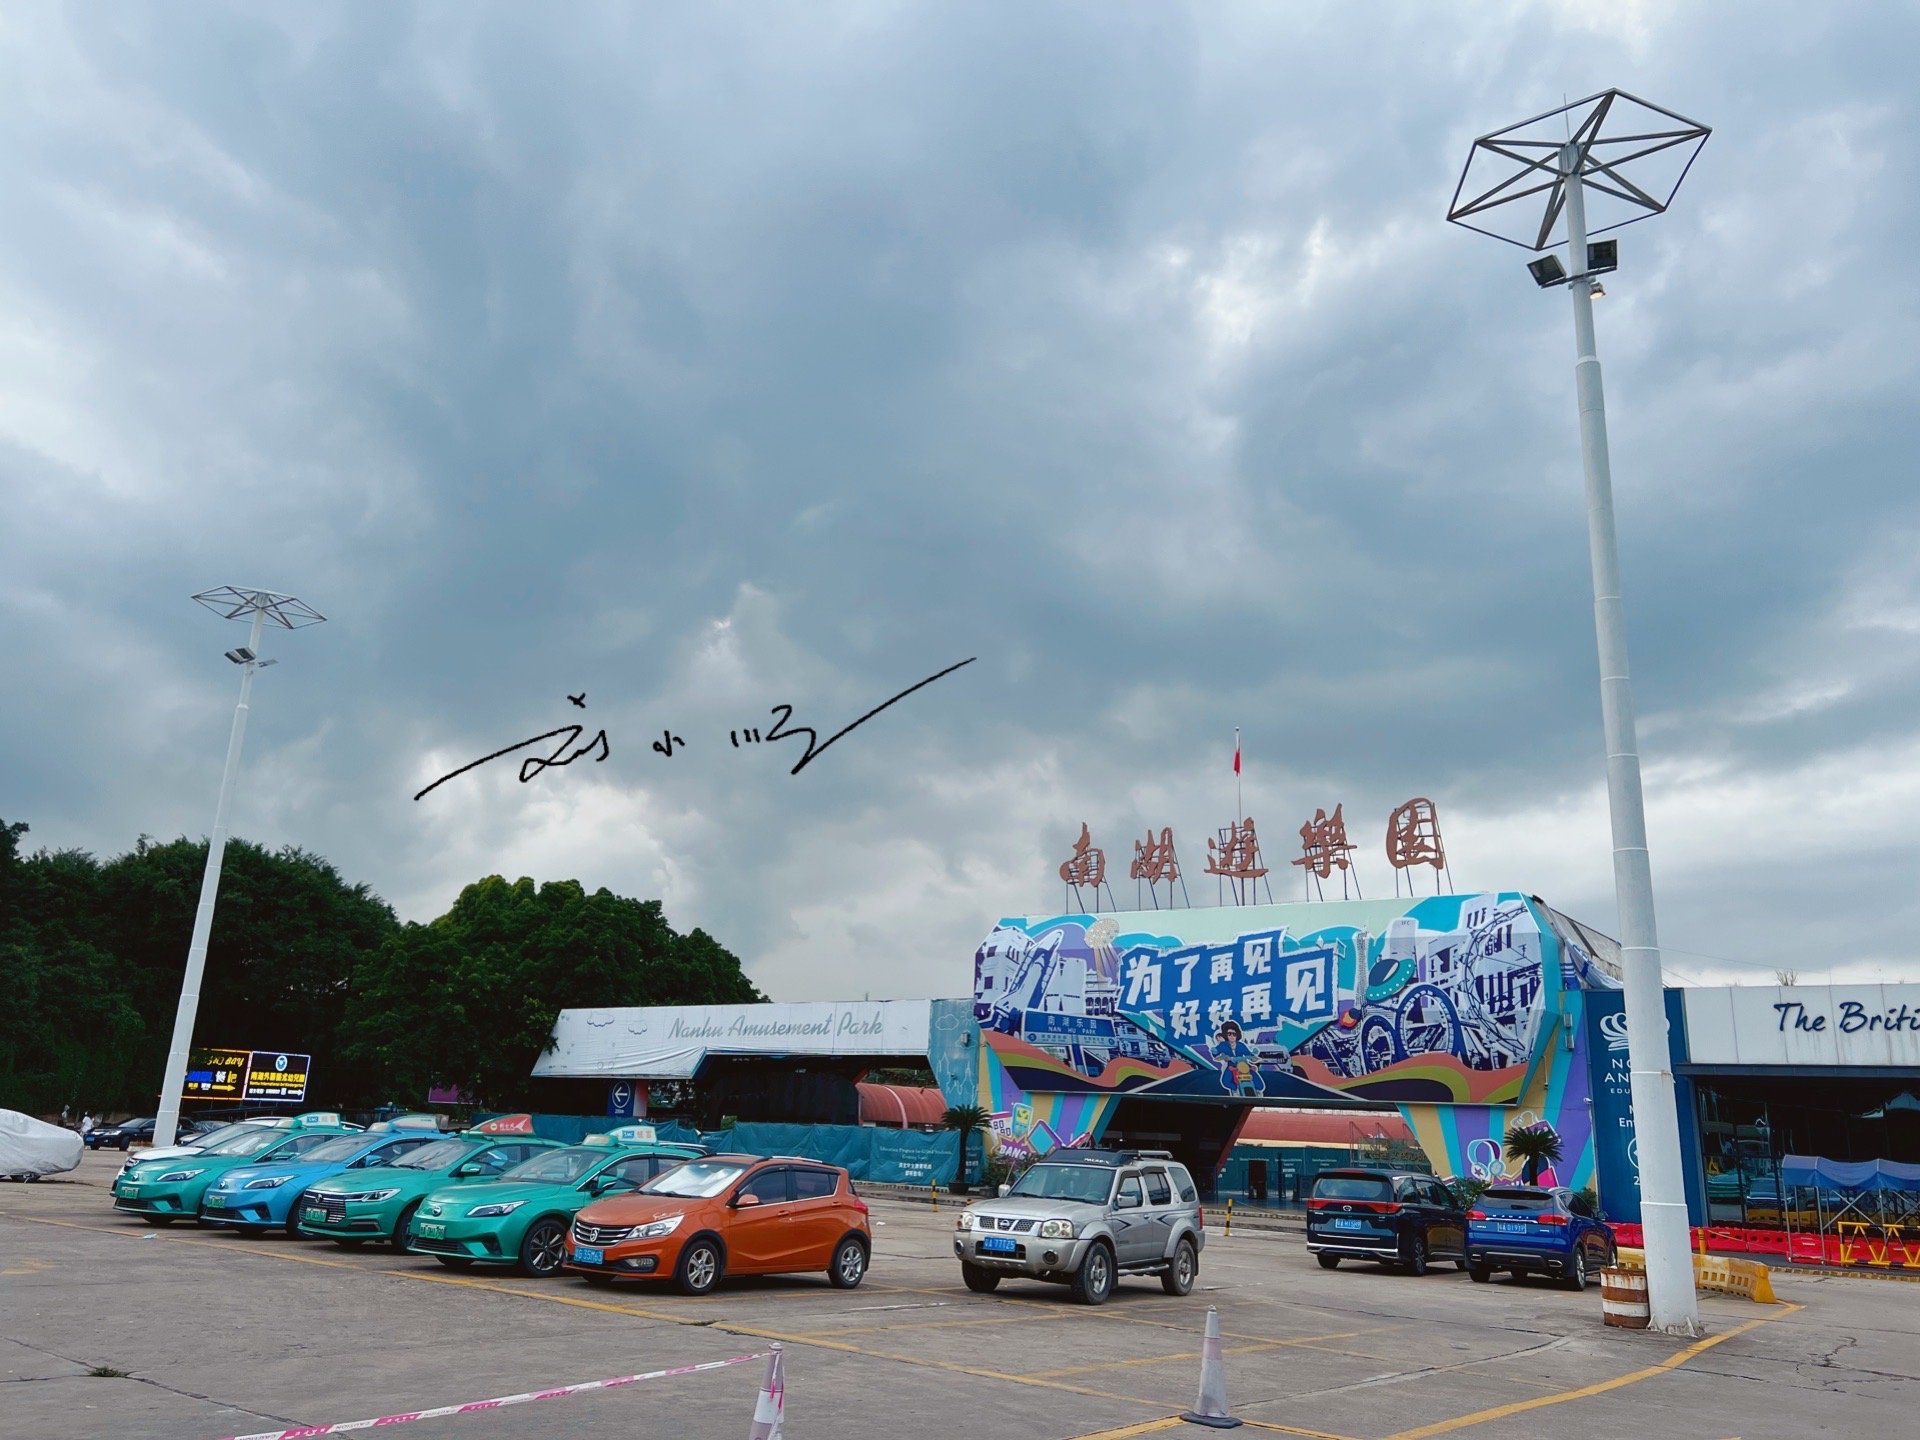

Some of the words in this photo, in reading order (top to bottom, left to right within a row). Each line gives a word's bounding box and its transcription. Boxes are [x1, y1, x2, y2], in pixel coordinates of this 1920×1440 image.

[1125, 937, 1273, 1005] 为了再见
[1170, 957, 1326, 1040] 好好再见
[667, 1017, 723, 1039] Nanhu
[727, 1013, 833, 1037] Amusement
[836, 1011, 884, 1037] Park
[1047, 1015, 1097, 1029] 南湖乐园
[1773, 1002, 1826, 1032] The
[993, 1120, 1005, 1130] 80
[336, 1421, 370, 1430] CAUTION
